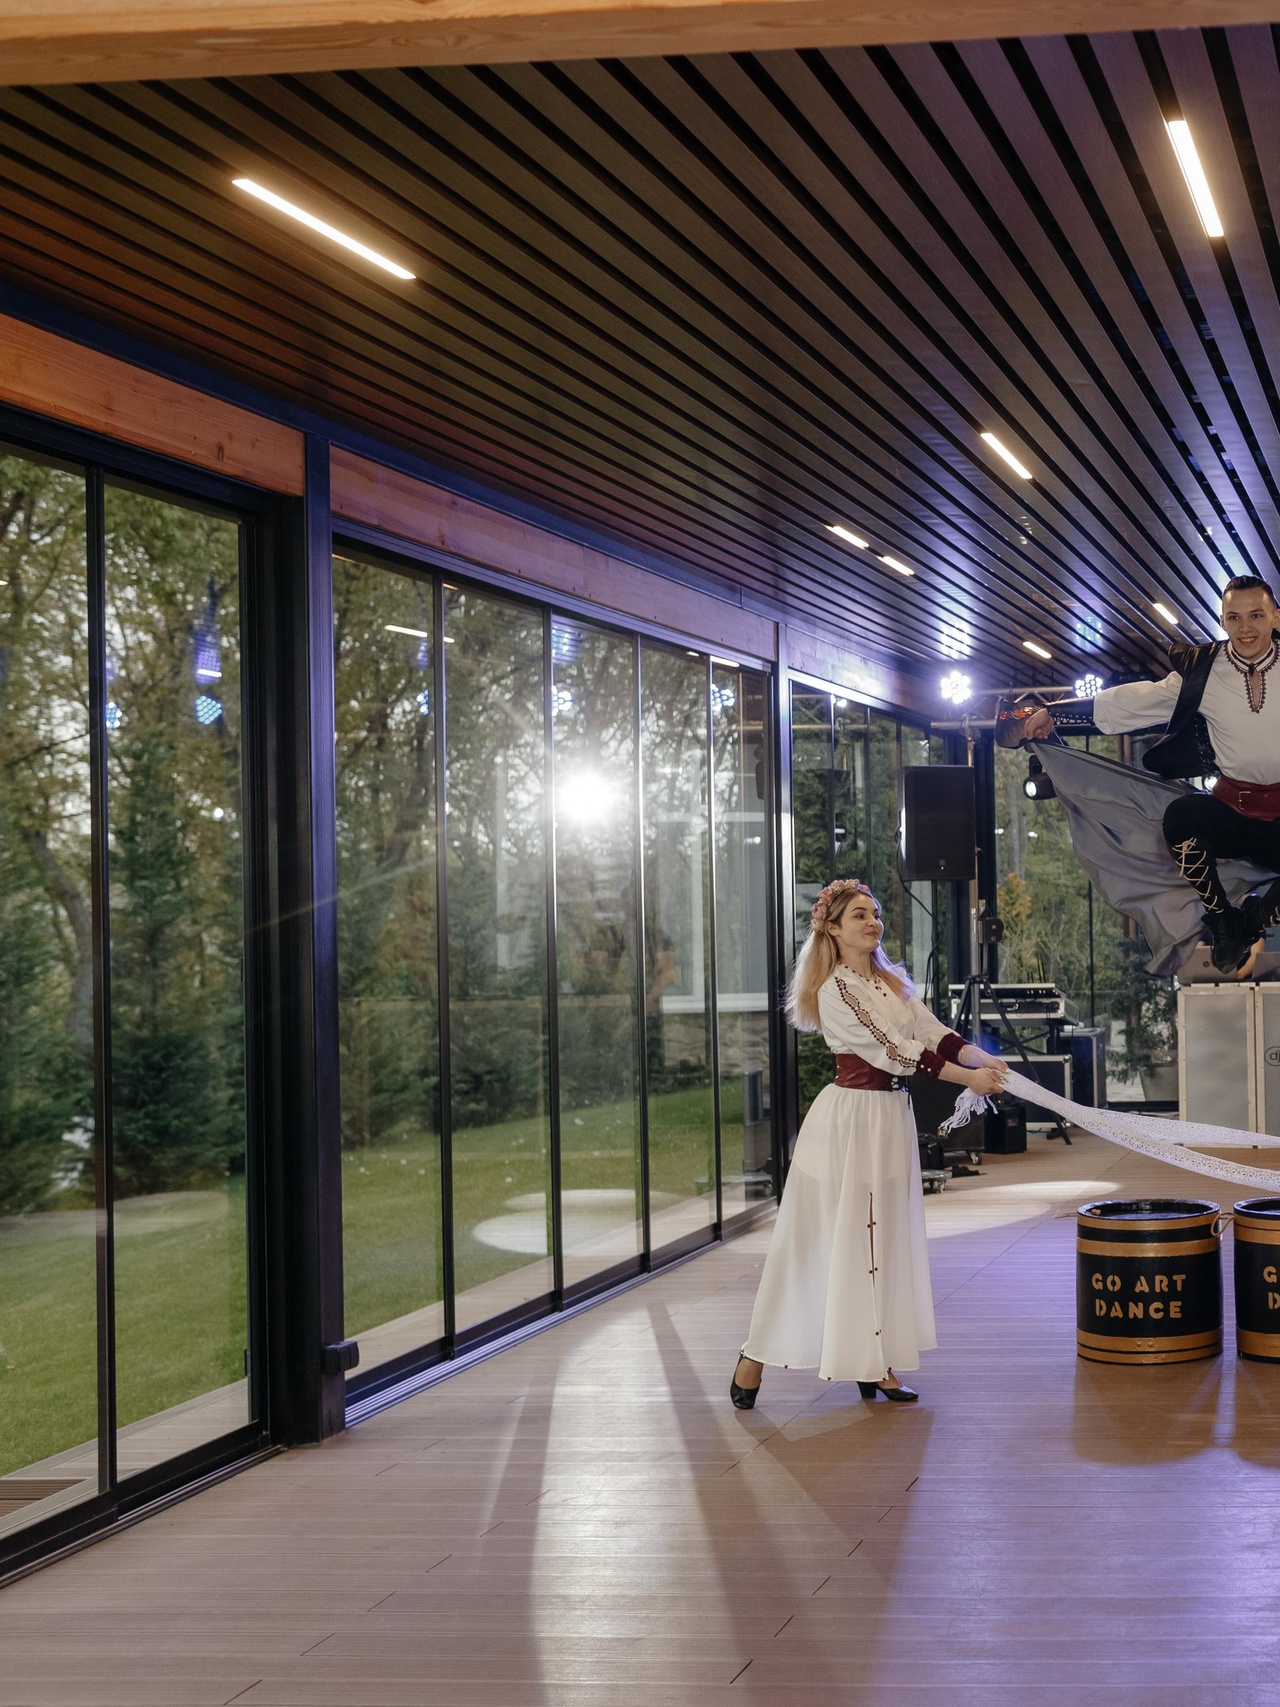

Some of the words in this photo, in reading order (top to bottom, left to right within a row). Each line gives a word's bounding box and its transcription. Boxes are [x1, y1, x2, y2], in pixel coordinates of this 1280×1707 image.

[1269, 1050, 1280, 1063] dj
[1092, 1273, 1121, 1291] GO
[1135, 1274, 1187, 1293] ART
[1095, 1299, 1182, 1319] DANCE
